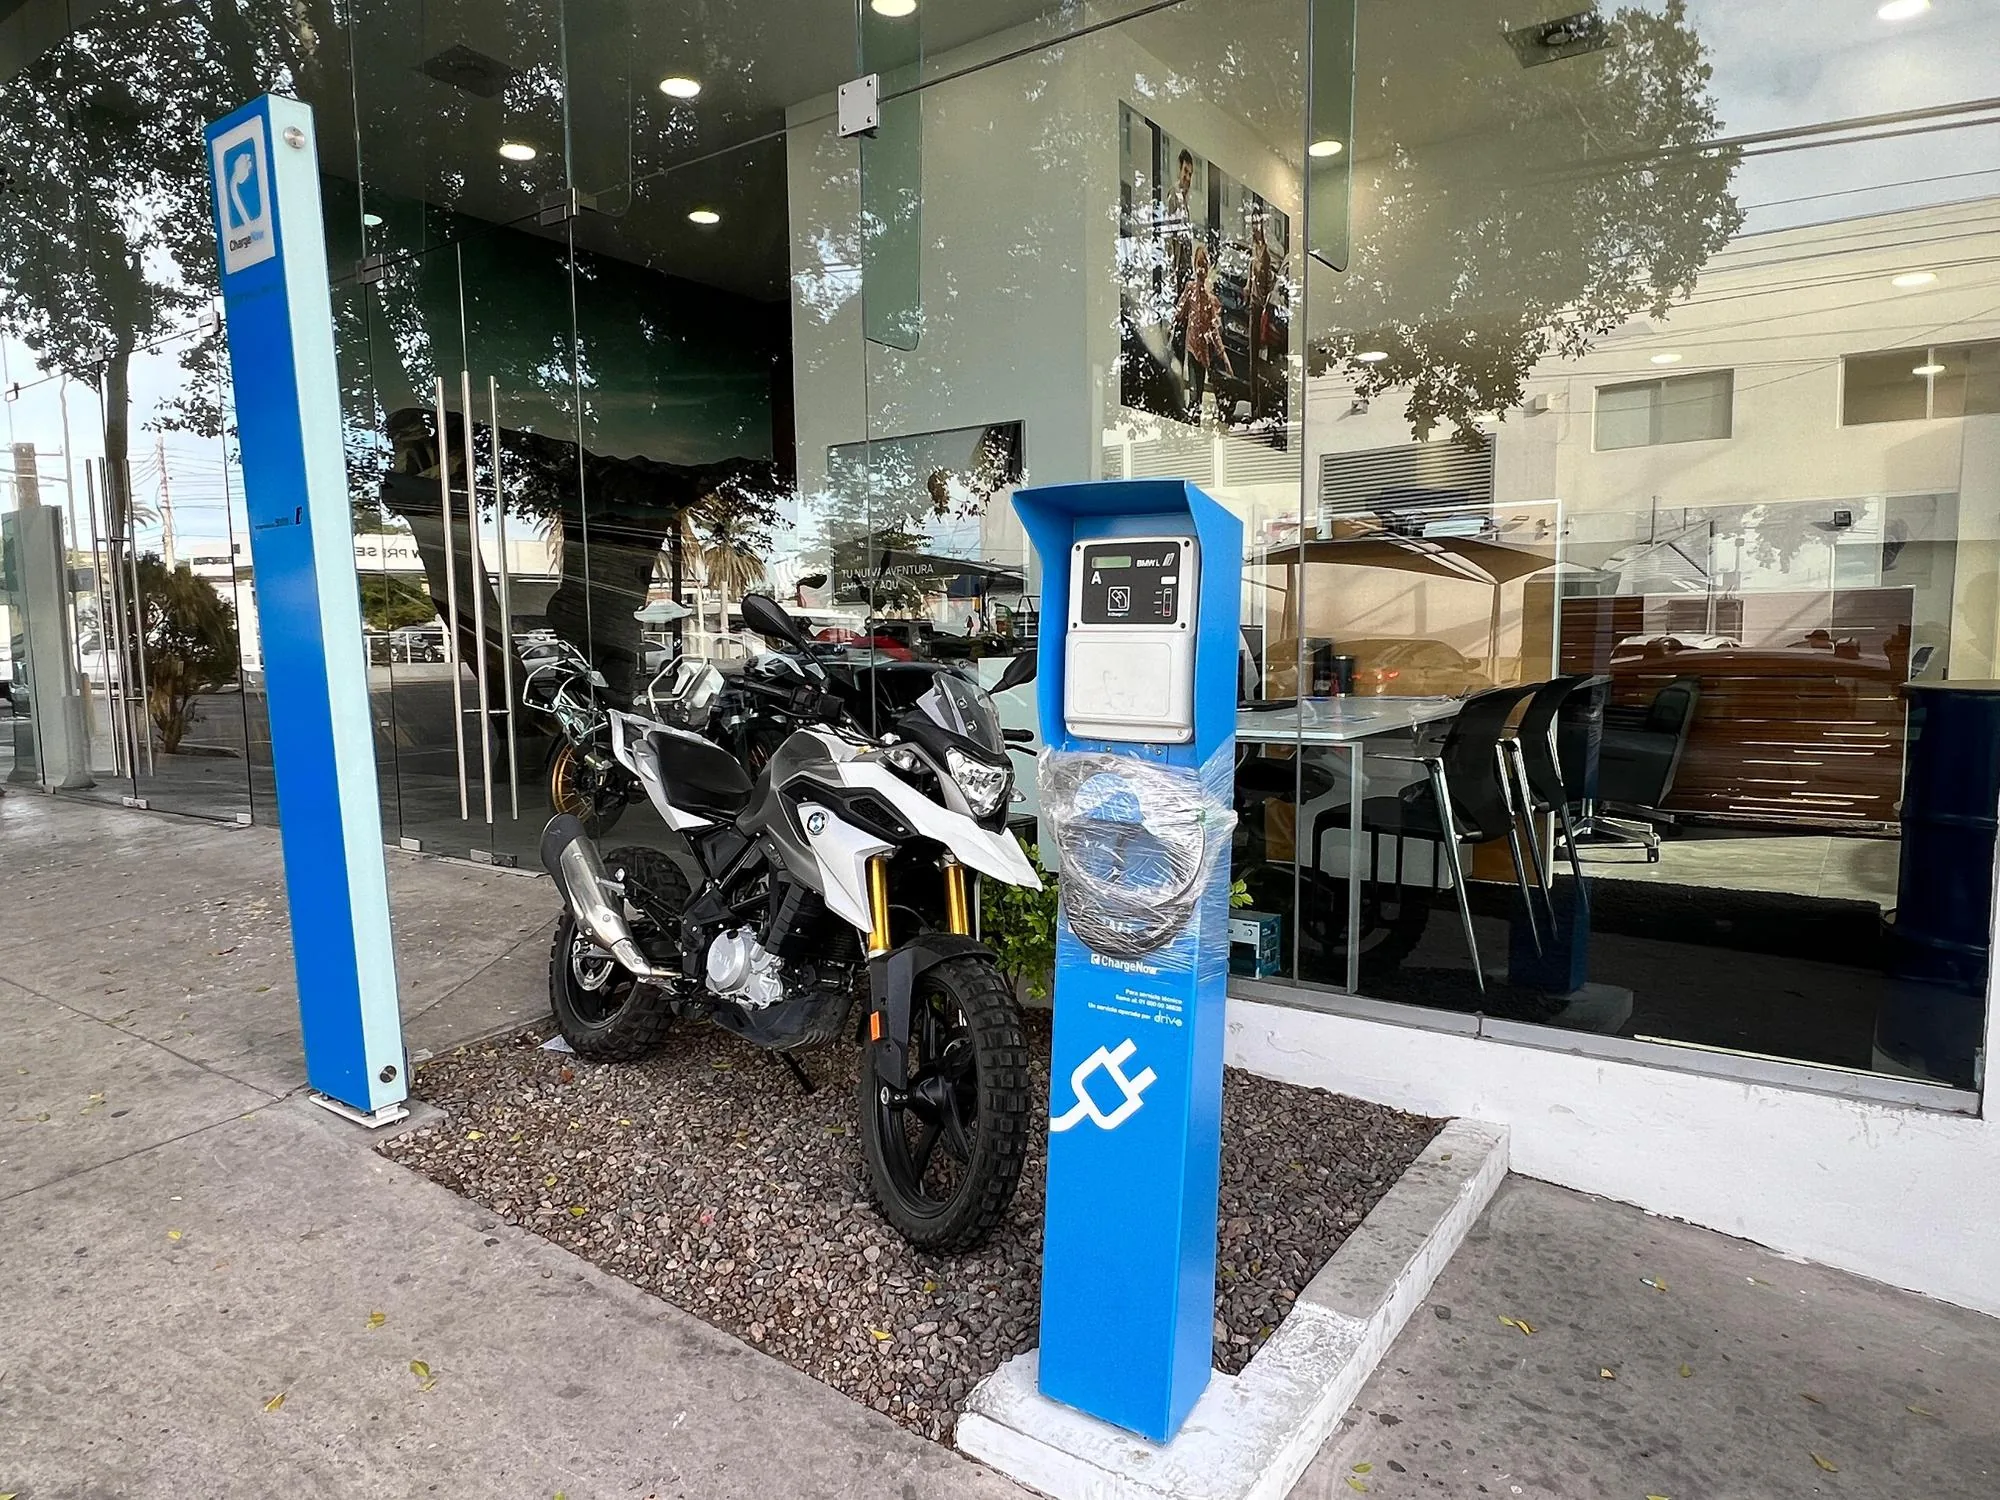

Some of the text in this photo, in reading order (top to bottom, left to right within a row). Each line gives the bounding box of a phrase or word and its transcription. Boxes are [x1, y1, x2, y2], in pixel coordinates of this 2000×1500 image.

[885, 563, 934, 577] AVENTURA
[1091, 570, 1102, 585] A
[1101, 956, 1157, 975] ChargeNow
